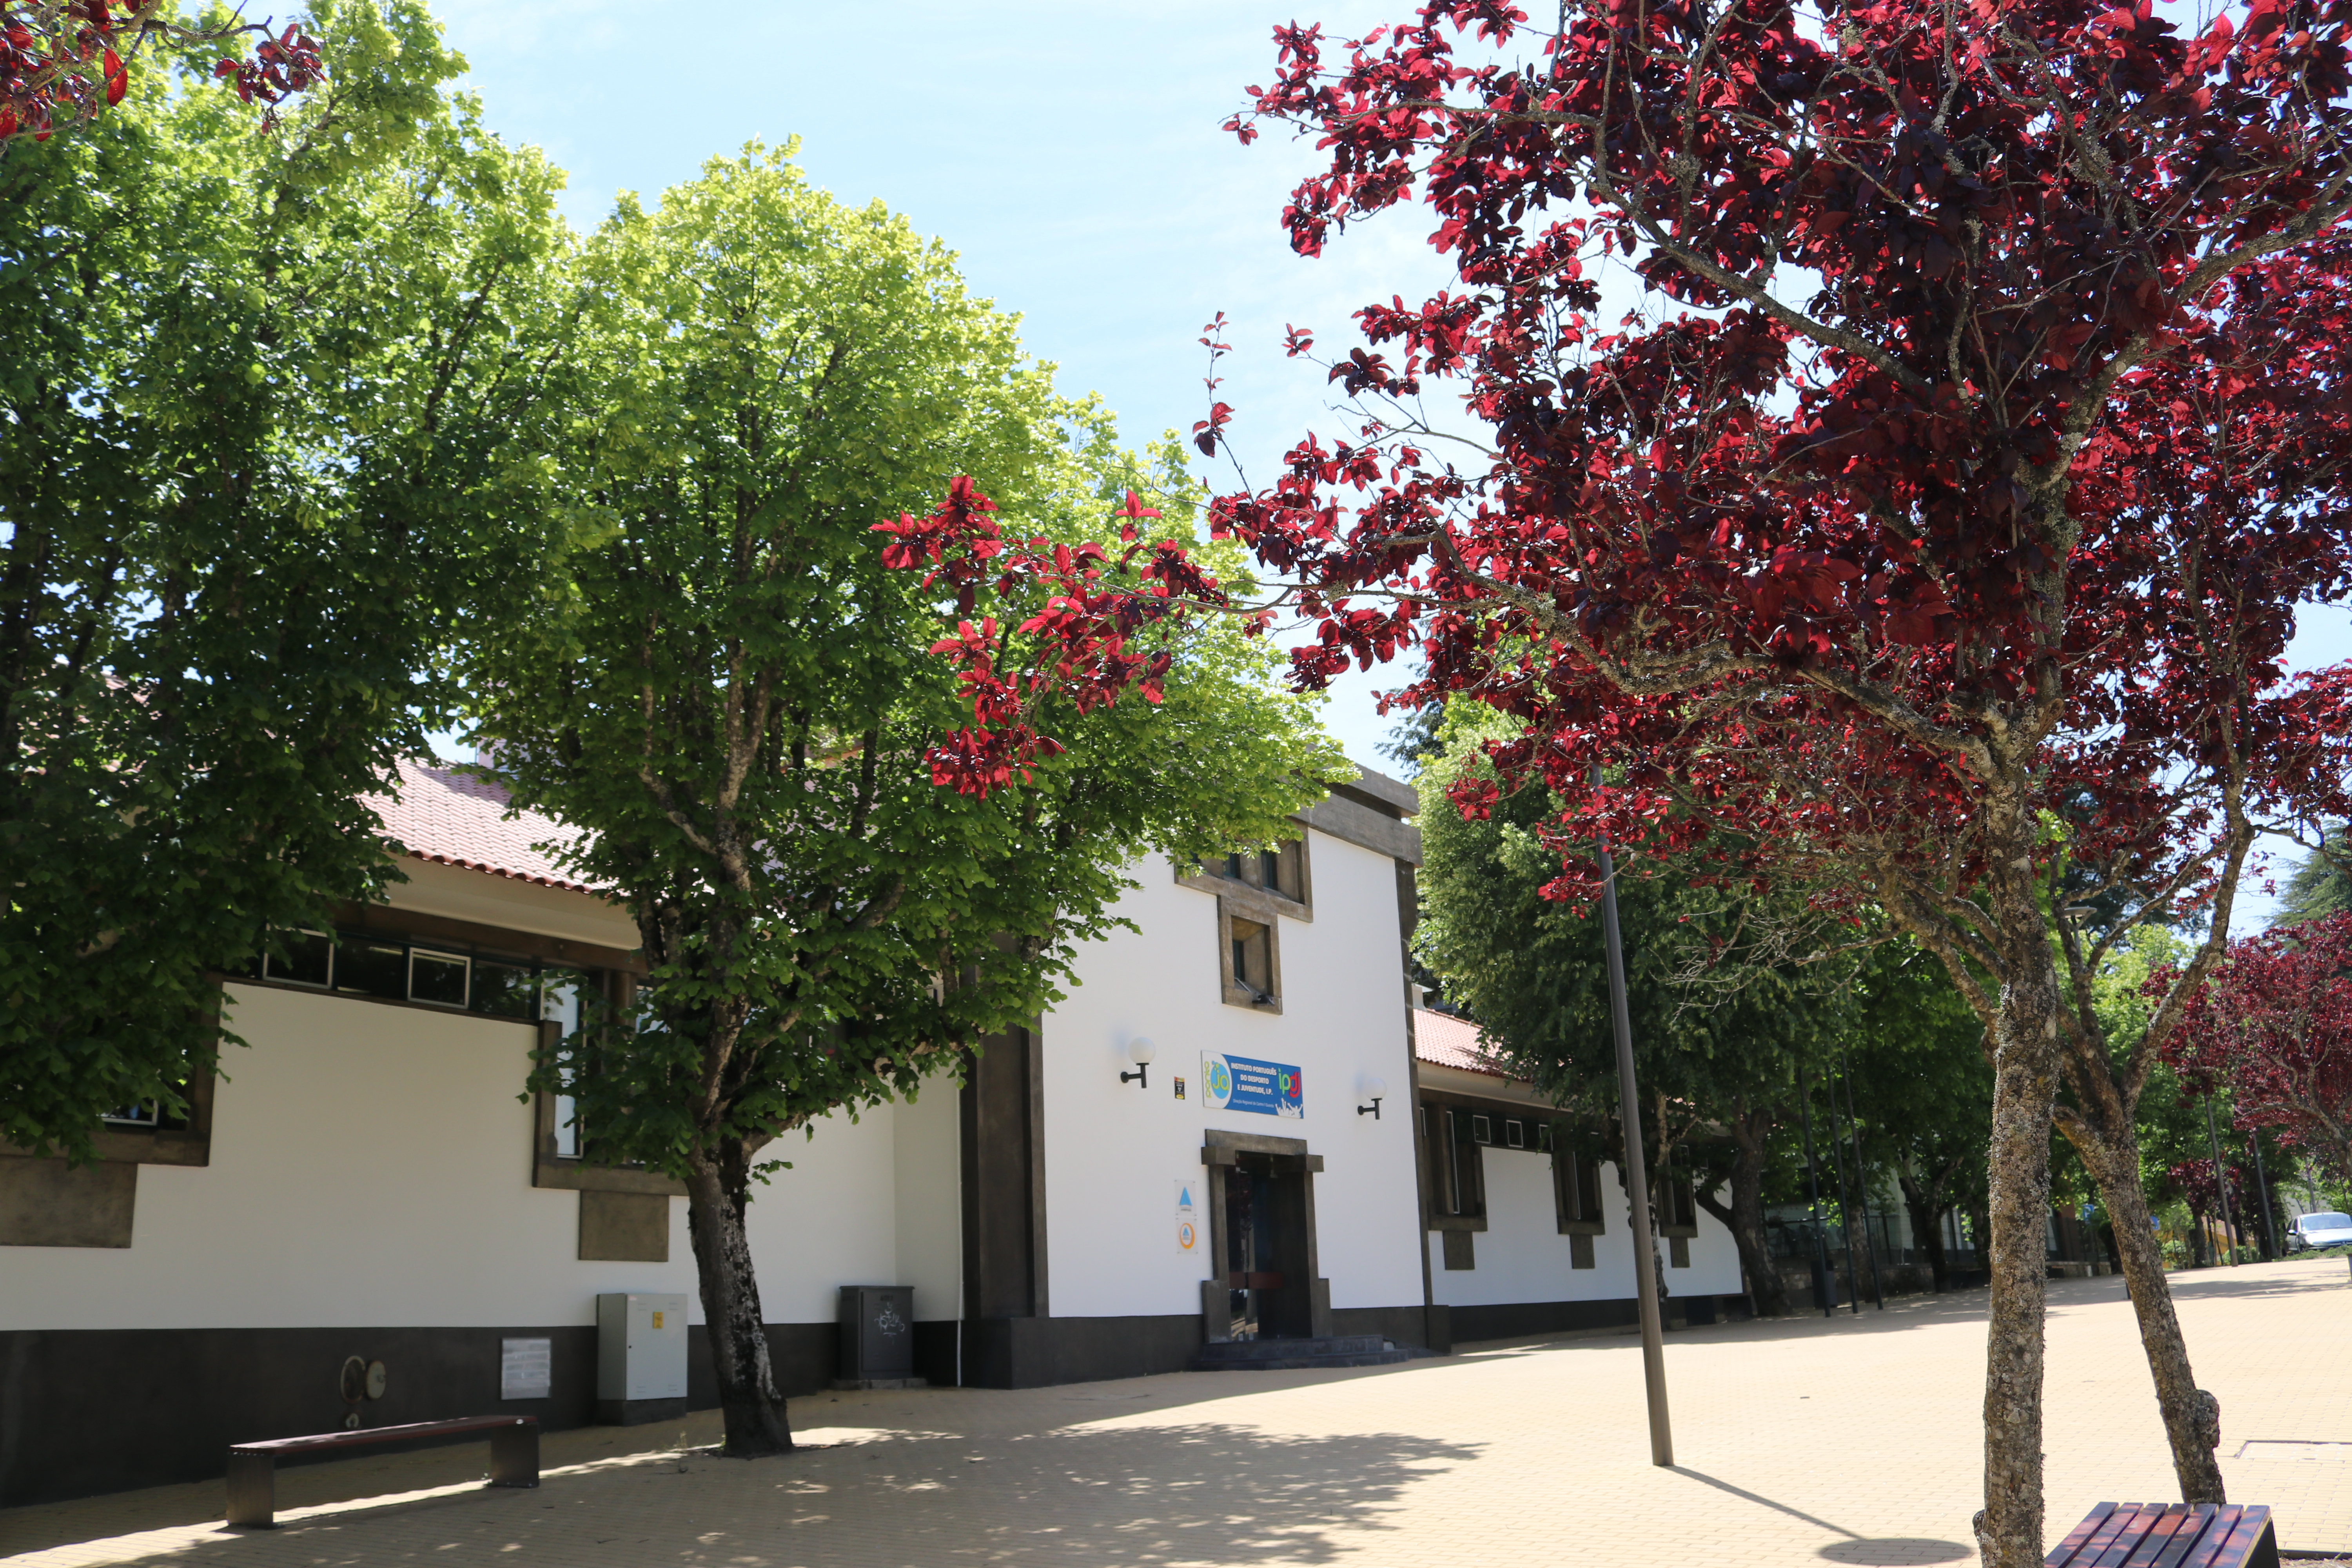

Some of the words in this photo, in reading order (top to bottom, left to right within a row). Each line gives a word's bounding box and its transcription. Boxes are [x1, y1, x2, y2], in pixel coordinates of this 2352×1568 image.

[1231, 1062, 1252, 1072] INSTITUTO
[1253, 1066, 1277, 1076] PORTUGUÊS
[1248, 1075, 1269, 1085] DESPORTO
[1278, 1068, 1300, 1098] ipdj
[1241, 1085, 1265, 1095] JUVENTUDE,
